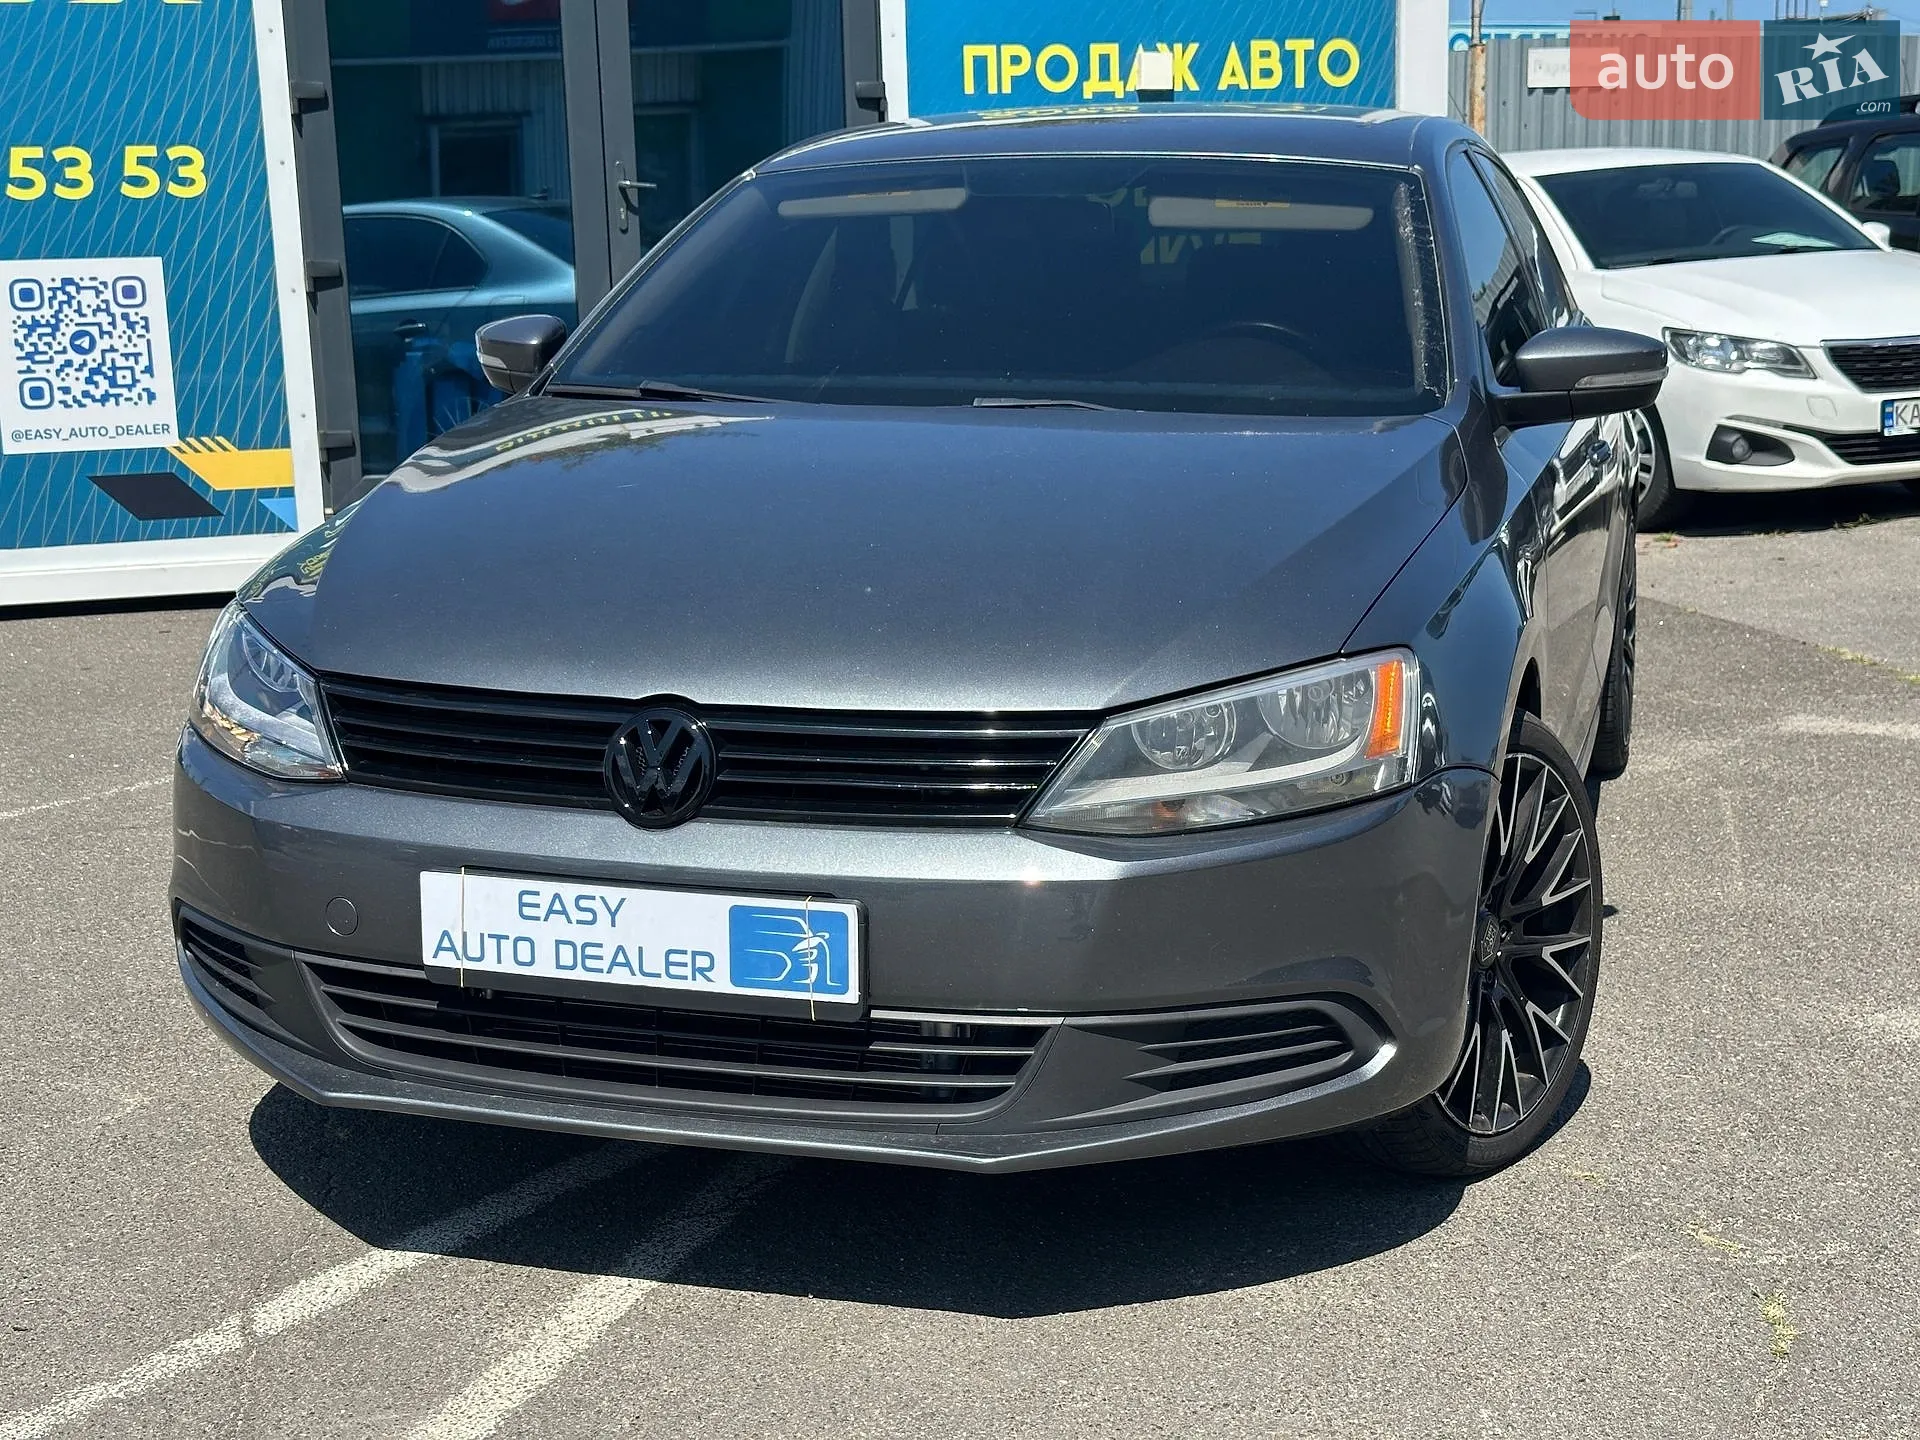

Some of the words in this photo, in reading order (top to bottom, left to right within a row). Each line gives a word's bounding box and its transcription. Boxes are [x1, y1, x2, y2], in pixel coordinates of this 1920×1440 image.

[1217, 37, 1360, 90] АВТО
[6, 146, 94, 200] 53
[120, 145, 207, 199] 53
[11, 423, 171, 443] @EASY_AUTO_DEALER
[517, 889, 627, 928] EASY
[432, 929, 536, 967] AUTO
[554, 939, 715, 983] DEALER
